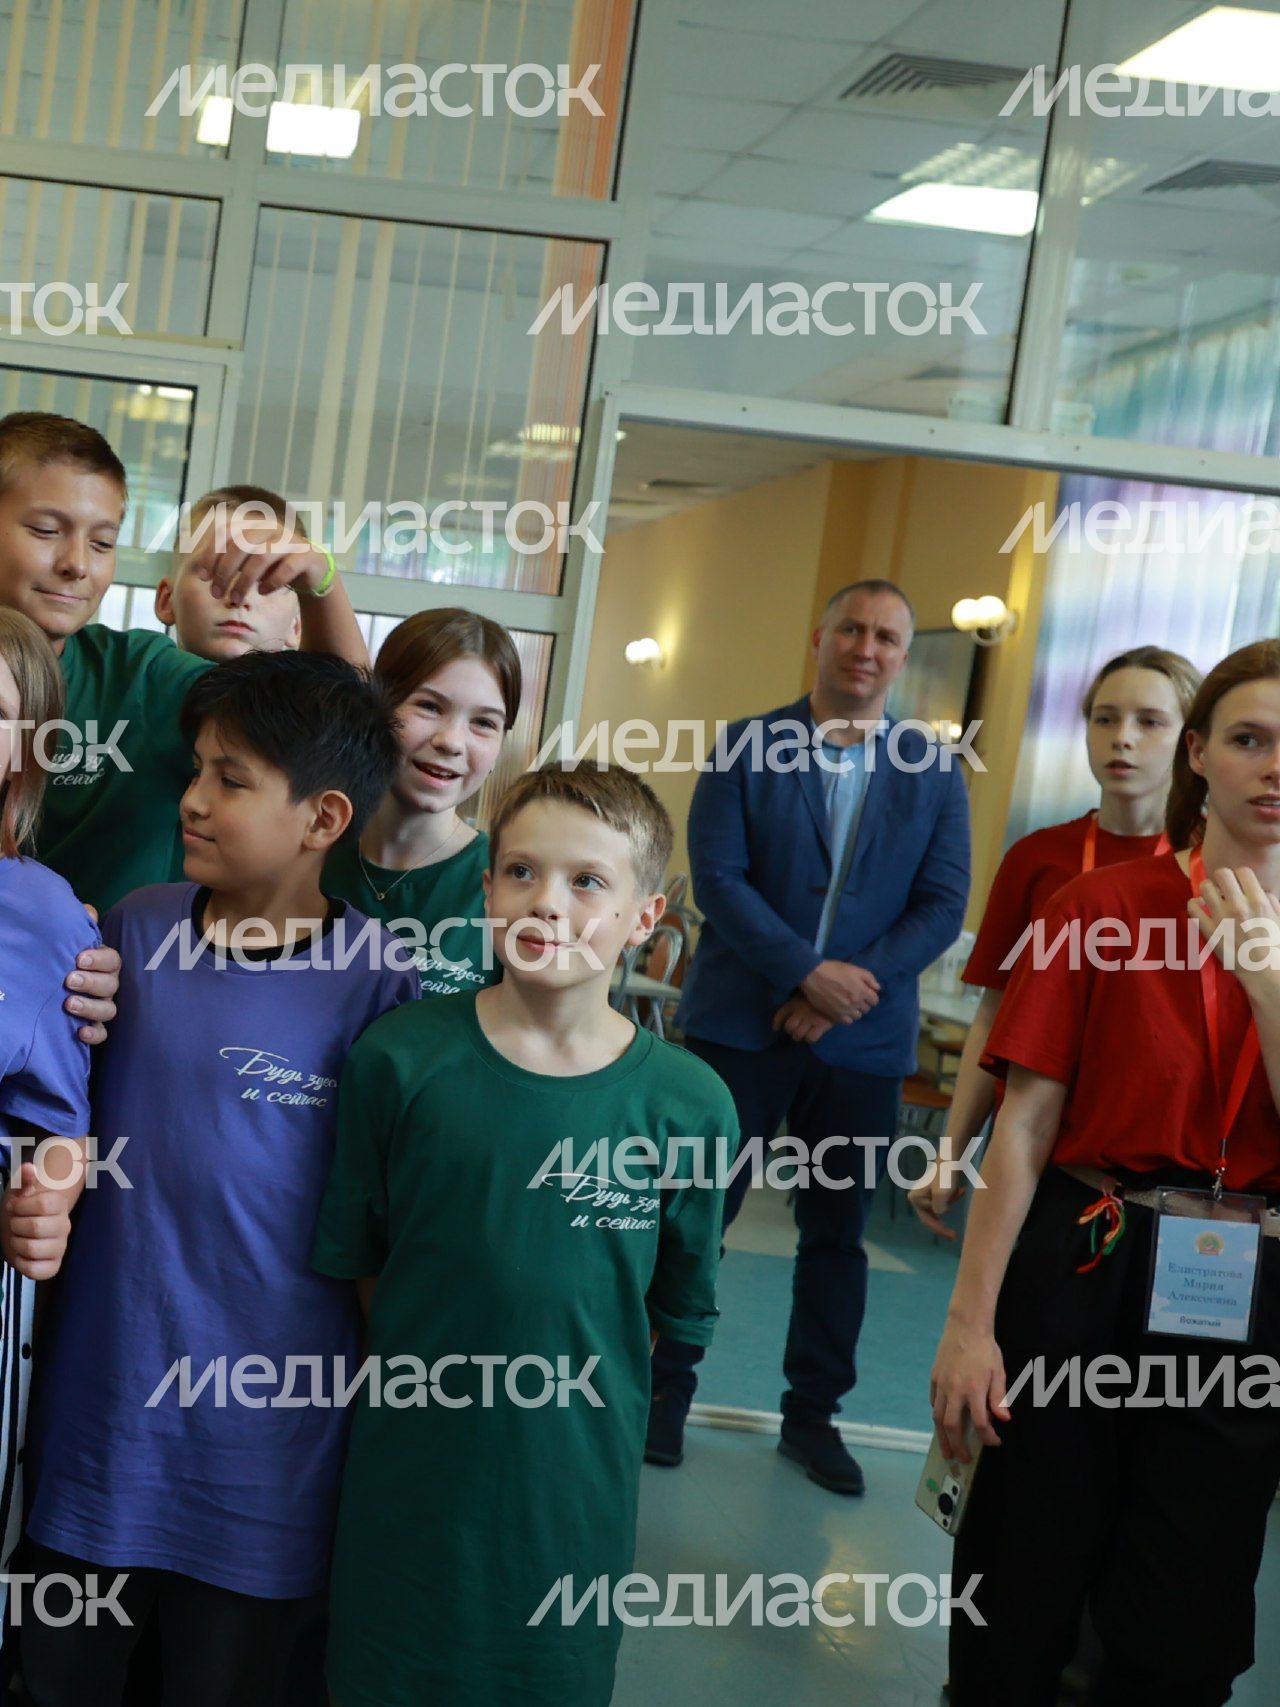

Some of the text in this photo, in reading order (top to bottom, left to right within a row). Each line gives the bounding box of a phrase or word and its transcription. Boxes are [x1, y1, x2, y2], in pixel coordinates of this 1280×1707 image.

[219, 1047, 303, 1085] Будь
[241, 1088, 329, 1108] и сейчас
[541, 1172, 661, 1213] Будь зде
[570, 1214, 657, 1230] и сейчас
[1183, 1277, 1225, 1292] Мария
